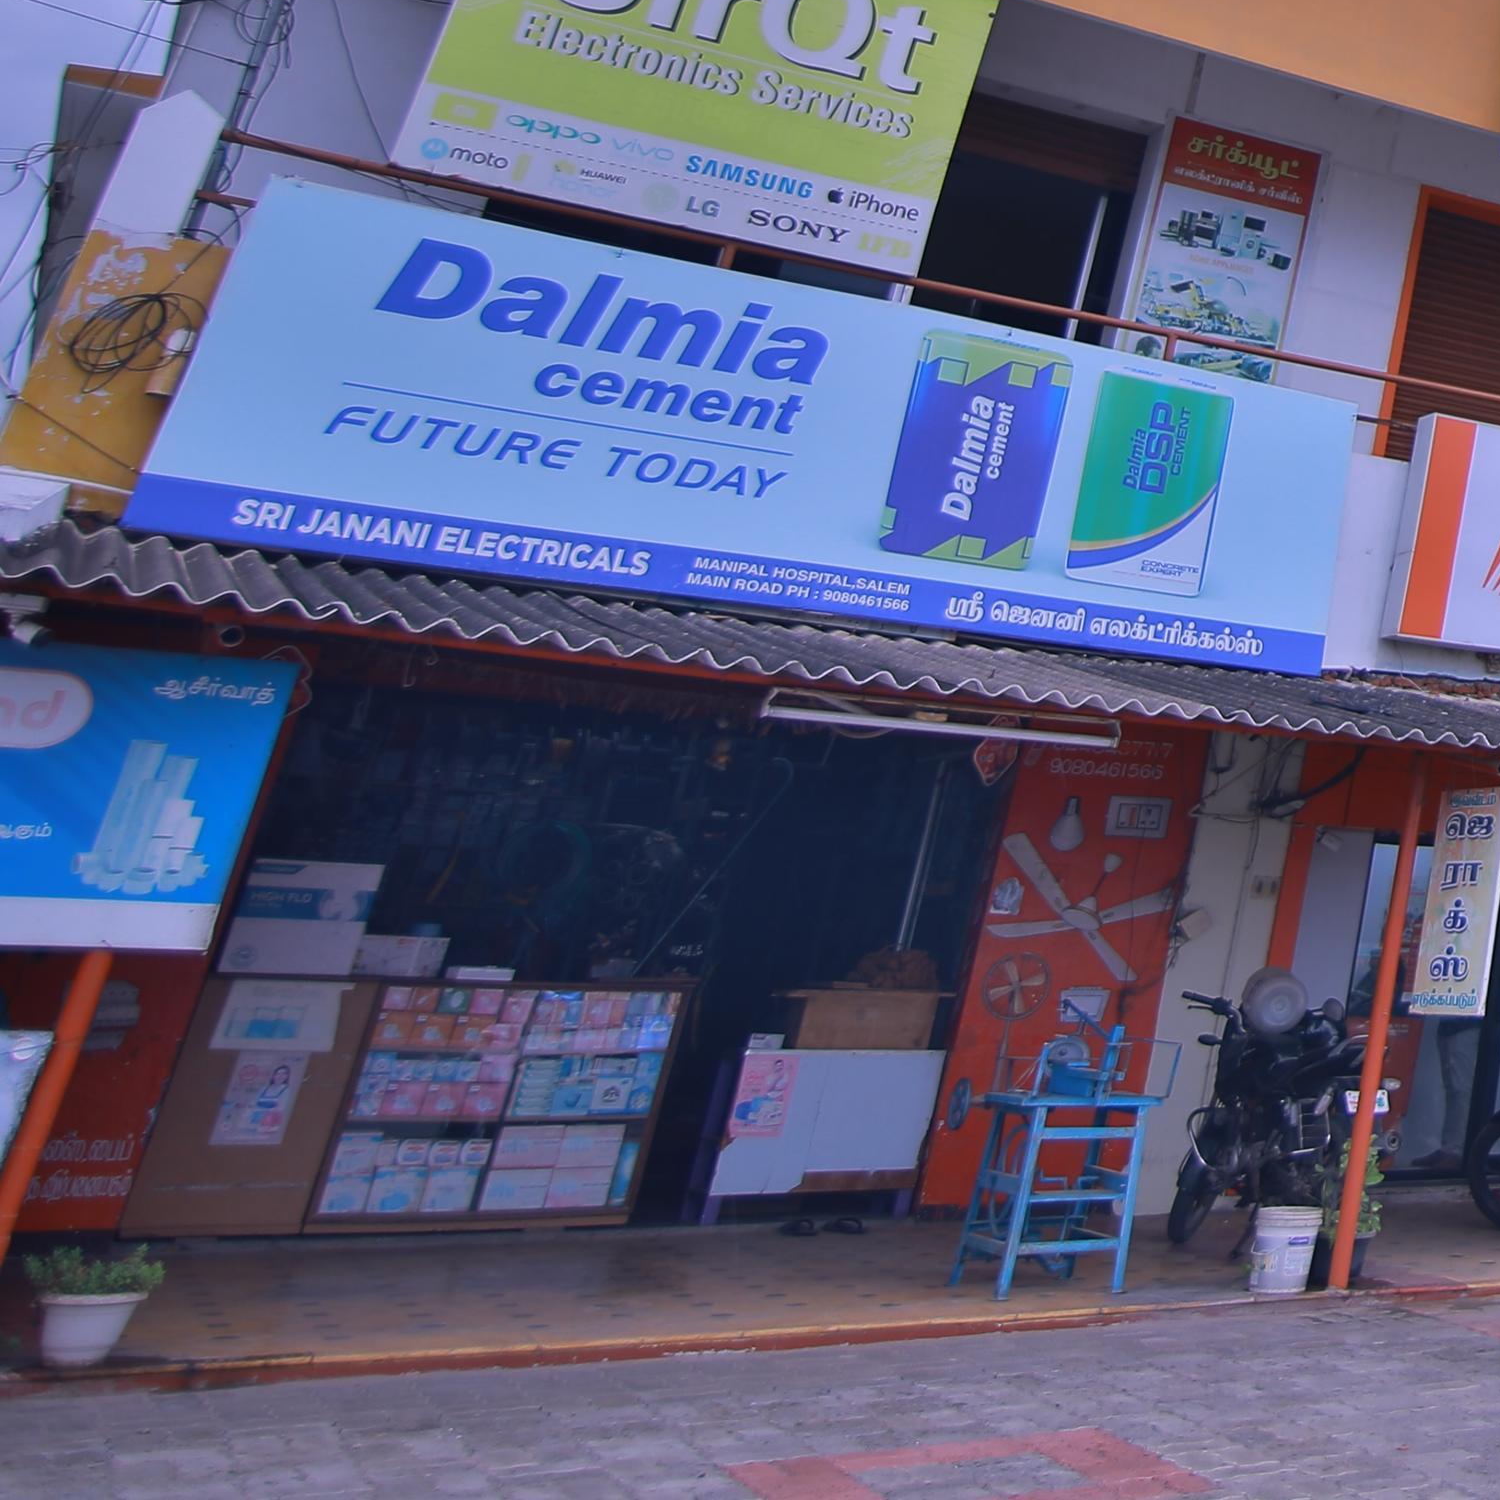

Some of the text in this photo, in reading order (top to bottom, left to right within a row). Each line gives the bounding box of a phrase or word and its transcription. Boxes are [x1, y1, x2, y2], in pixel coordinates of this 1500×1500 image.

[514, 10, 913, 139] Electronics Services
[450, 147, 508, 169] moto
[580, 168, 627, 185] HUAWEI
[686, 196, 720, 218] LG
[748, 208, 849, 243] SONY
[506, 115, 919, 221] oppo vivo SAMSUNG iPhone
[374, 237, 830, 387] Dalmia
[534, 362, 803, 435] cement
[324, 404, 788, 499] FUTURE TODAY
[941, 394, 996, 521] Dalmia
[986, 401, 1015, 480] cement
[1122, 428, 1146, 490] Dalmia
[1138, 401, 1176, 494] DSP
[1171, 406, 1191, 477] CEMENT
[233, 498, 651, 577] SRI JANANI ELECTRICALS
[694, 556, 911, 595] MANIPAL HOSPITAL,SALEM
[1140, 565, 1184, 577] EXPERT
[1142, 559, 1199, 574] CONCRETE
[687, 572, 909, 611] MAIN ROAD PH 9080461566
[991, 600, 1086, 633] ஜெனனி
[1090, 613, 1264, 657] எலக்ட்ரிக்கல்ஸ்
[153, 675, 276, 706] ஆசீர்வாத்
